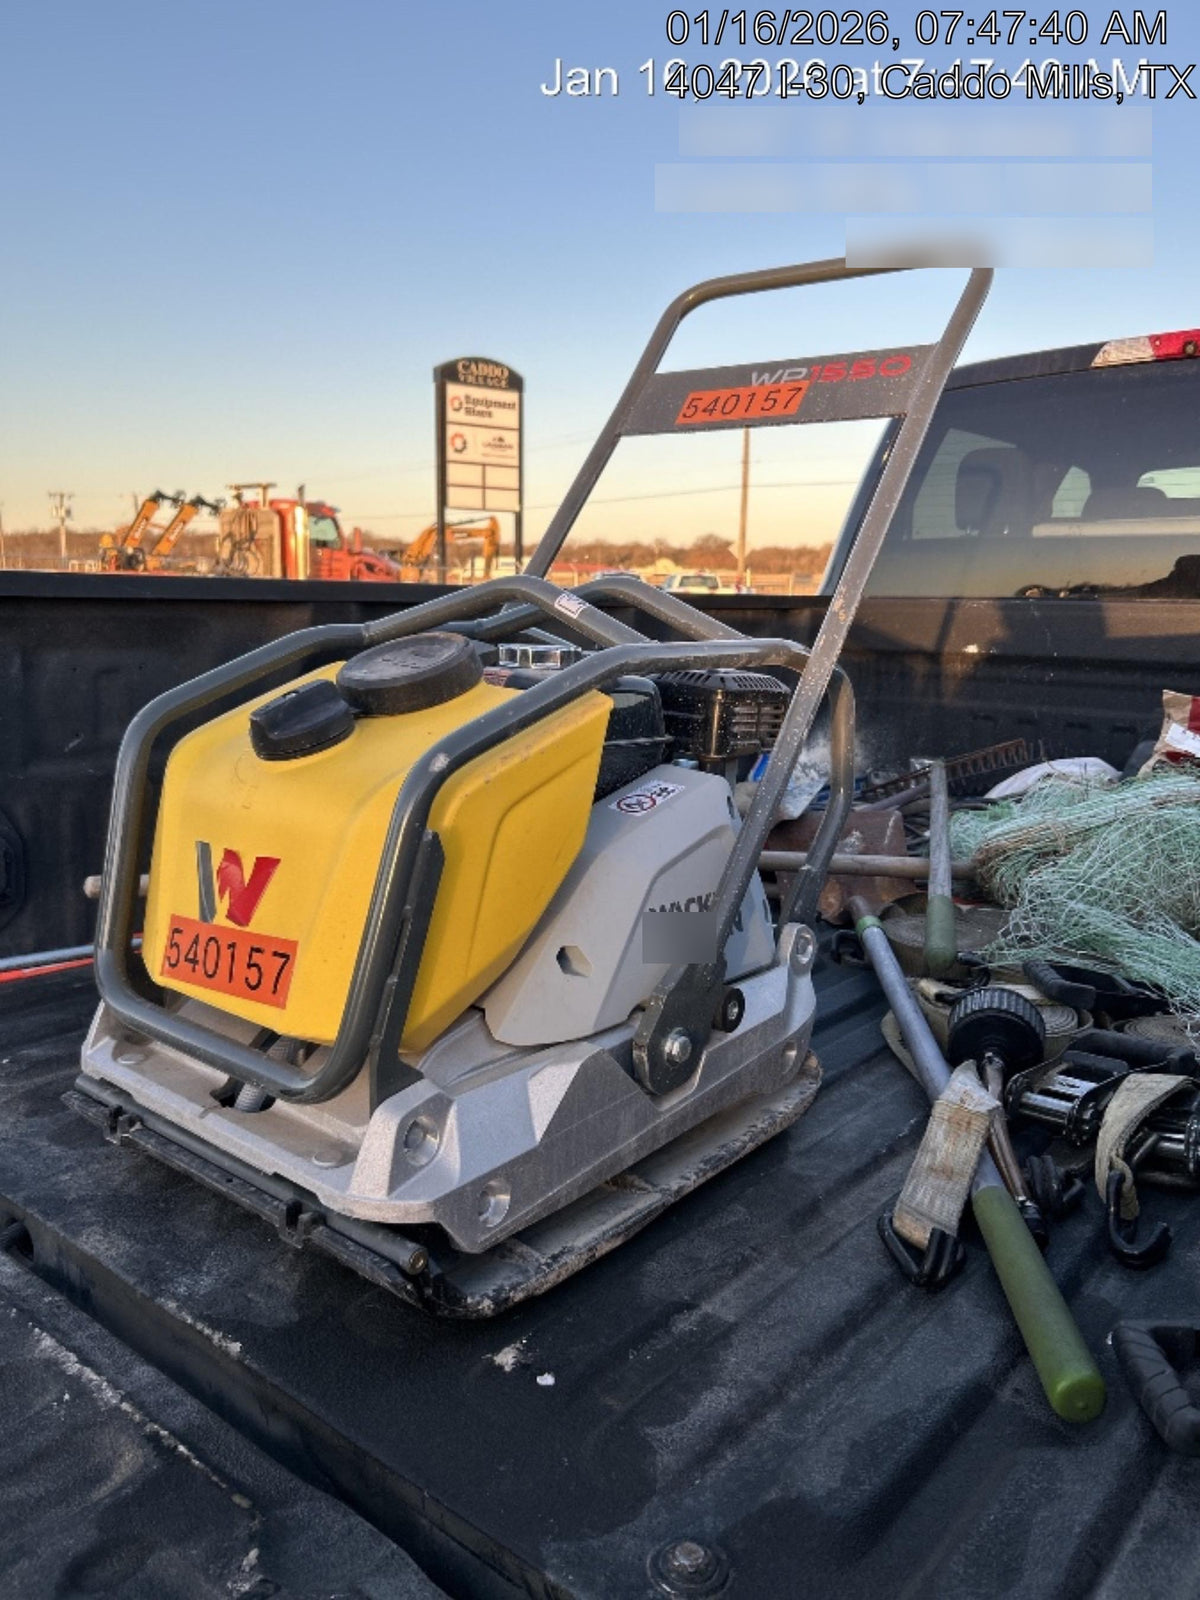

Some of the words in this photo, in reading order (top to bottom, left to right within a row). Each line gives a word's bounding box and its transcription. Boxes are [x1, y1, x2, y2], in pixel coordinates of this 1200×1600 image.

[751, 355, 912, 387] WP1550
[682, 386, 803, 419] 540157
[166, 927, 291, 995] 540157
